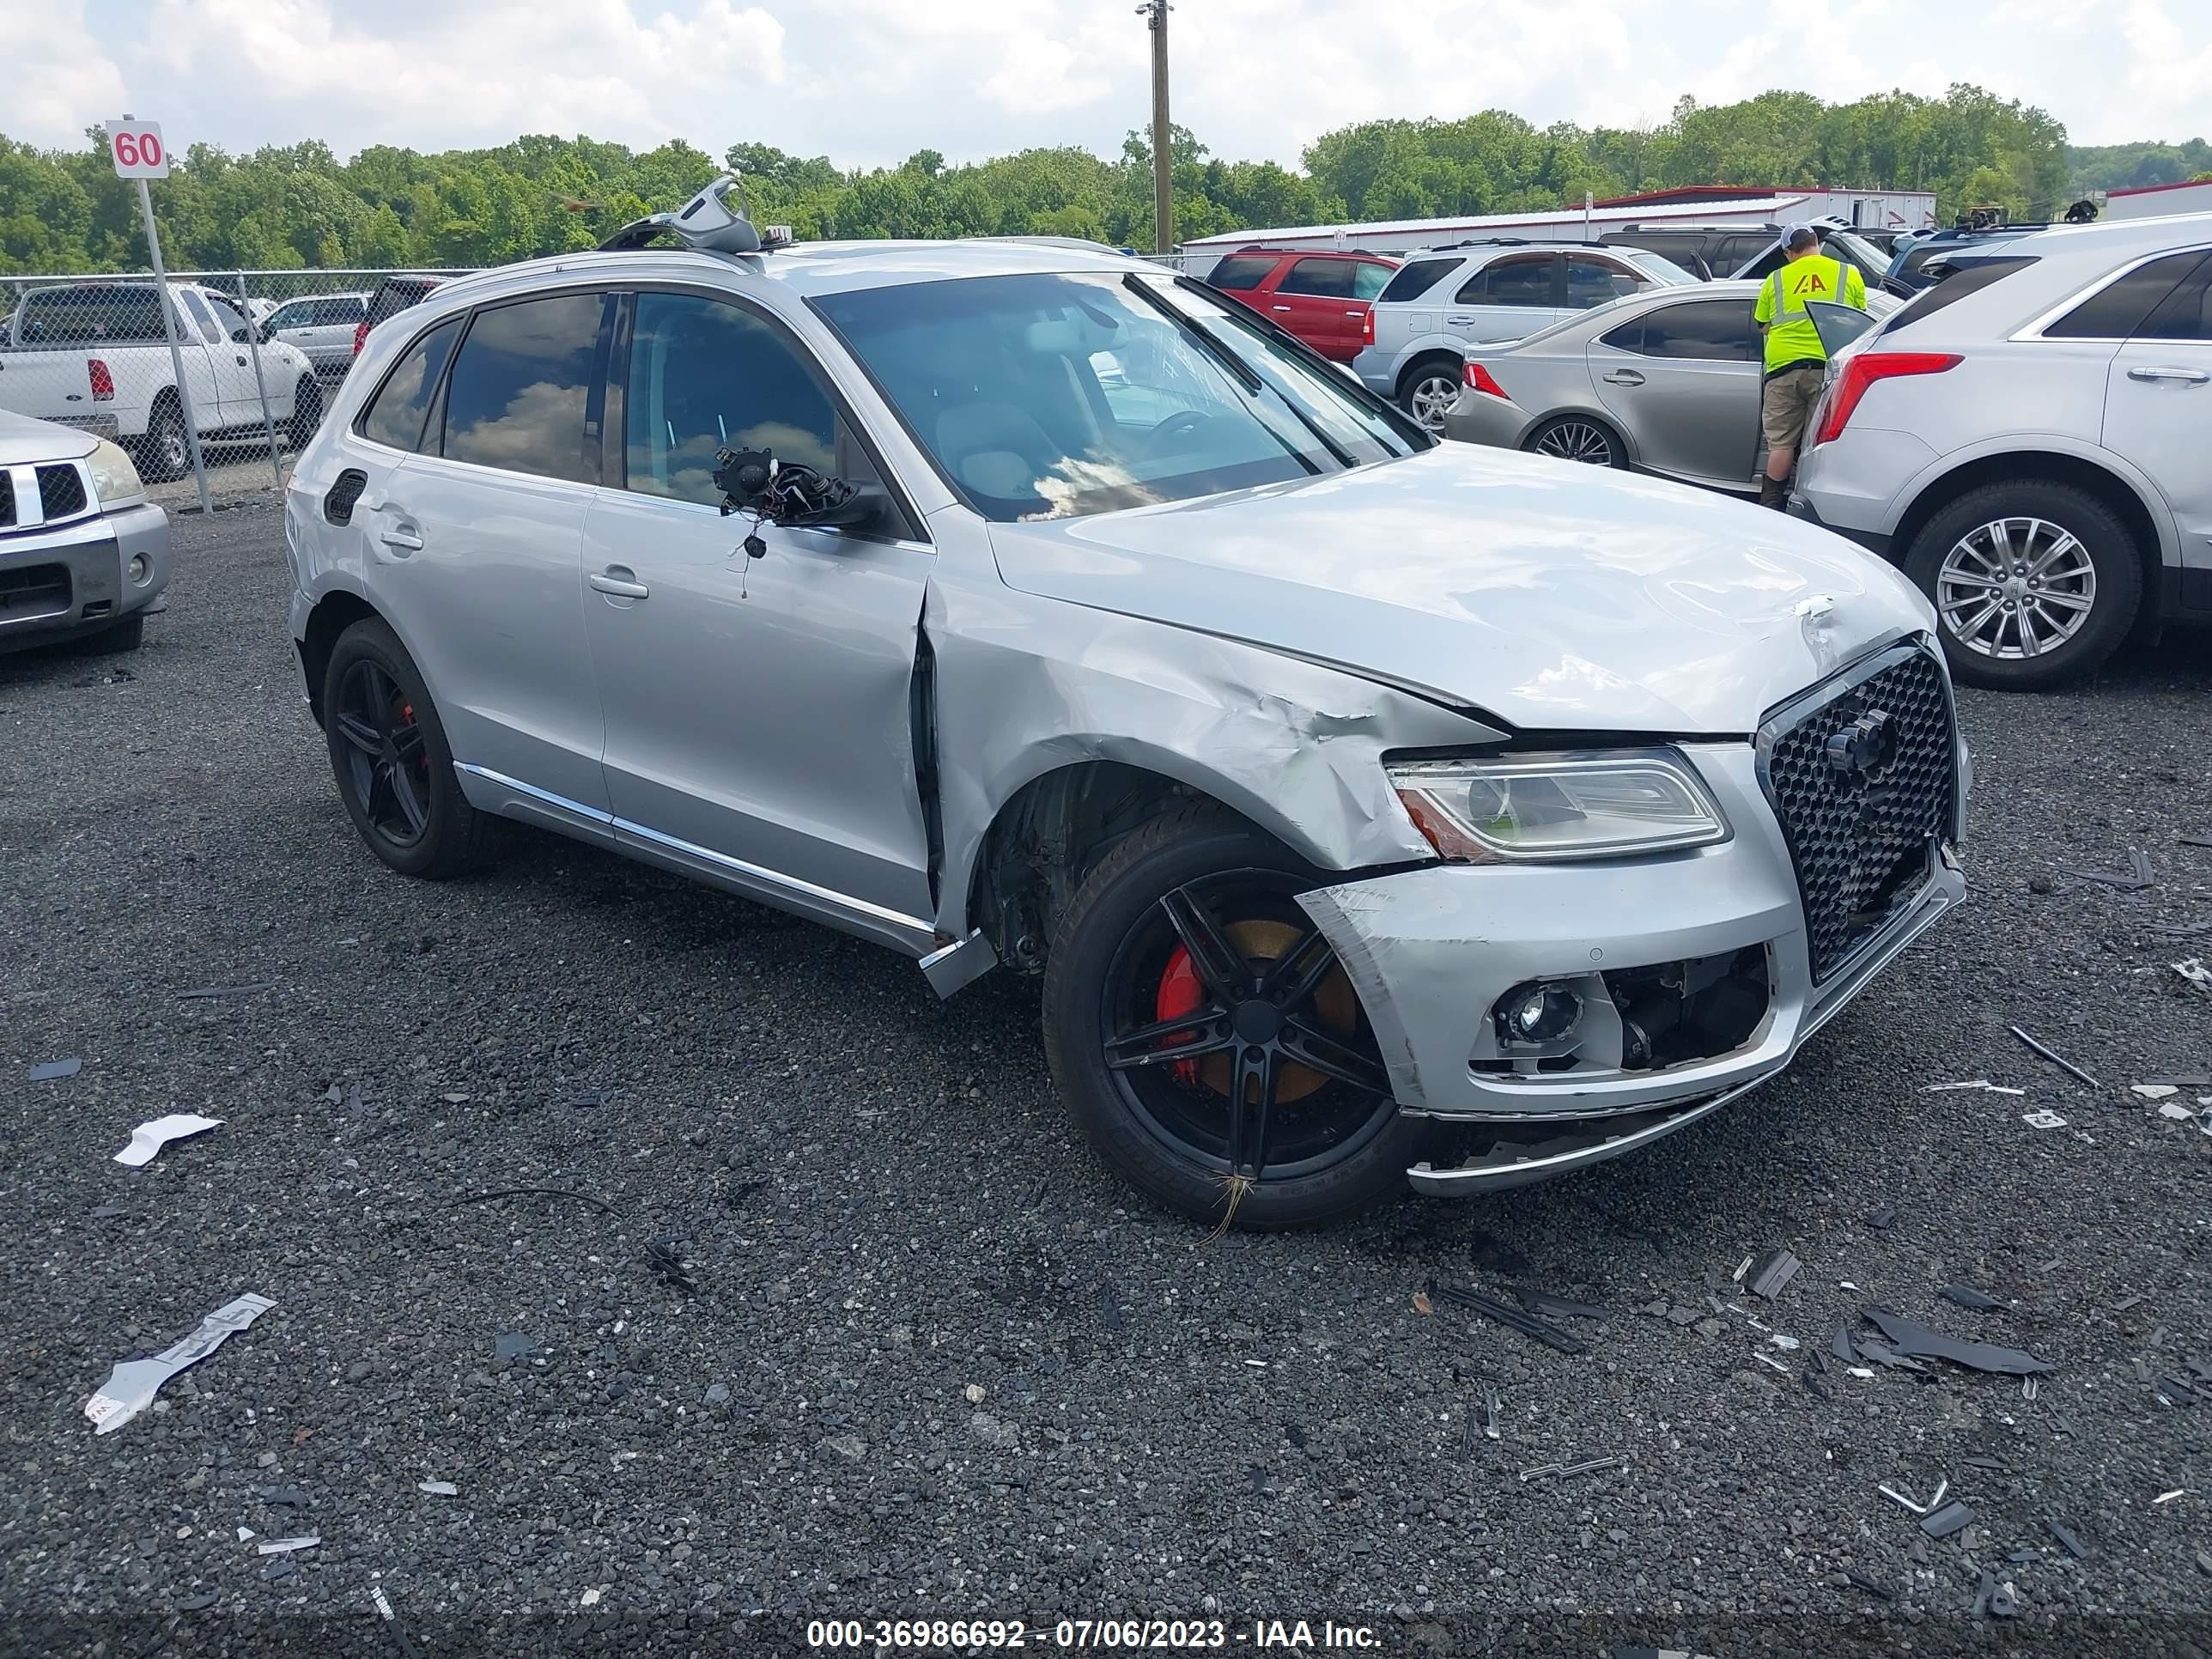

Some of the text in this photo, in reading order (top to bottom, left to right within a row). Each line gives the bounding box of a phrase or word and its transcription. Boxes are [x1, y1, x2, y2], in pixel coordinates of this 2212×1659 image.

[115, 132, 161, 167] 60
[370, 1586, 395, 1621] TO GROUP
